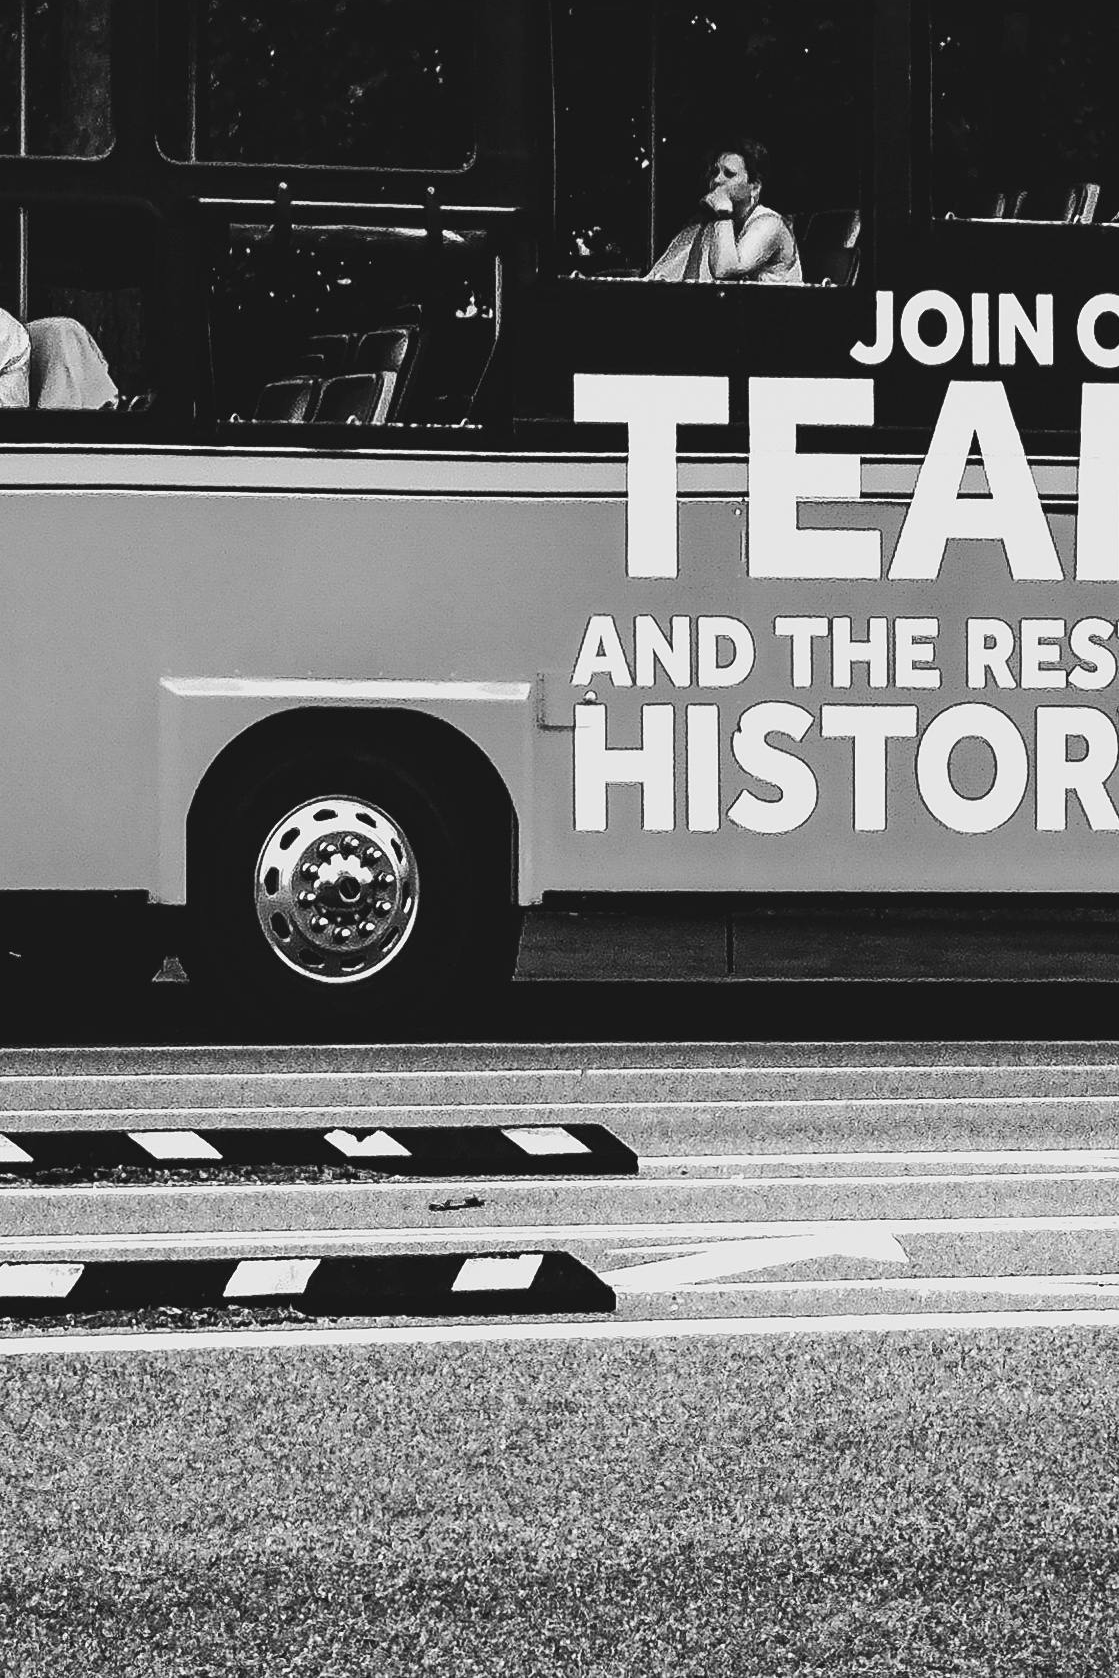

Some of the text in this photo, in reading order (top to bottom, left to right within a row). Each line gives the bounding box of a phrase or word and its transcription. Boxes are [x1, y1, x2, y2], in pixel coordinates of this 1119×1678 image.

[849, 288, 1055, 366] JOIN
[570, 614, 755, 688] AND
[774, 616, 942, 690] THE
